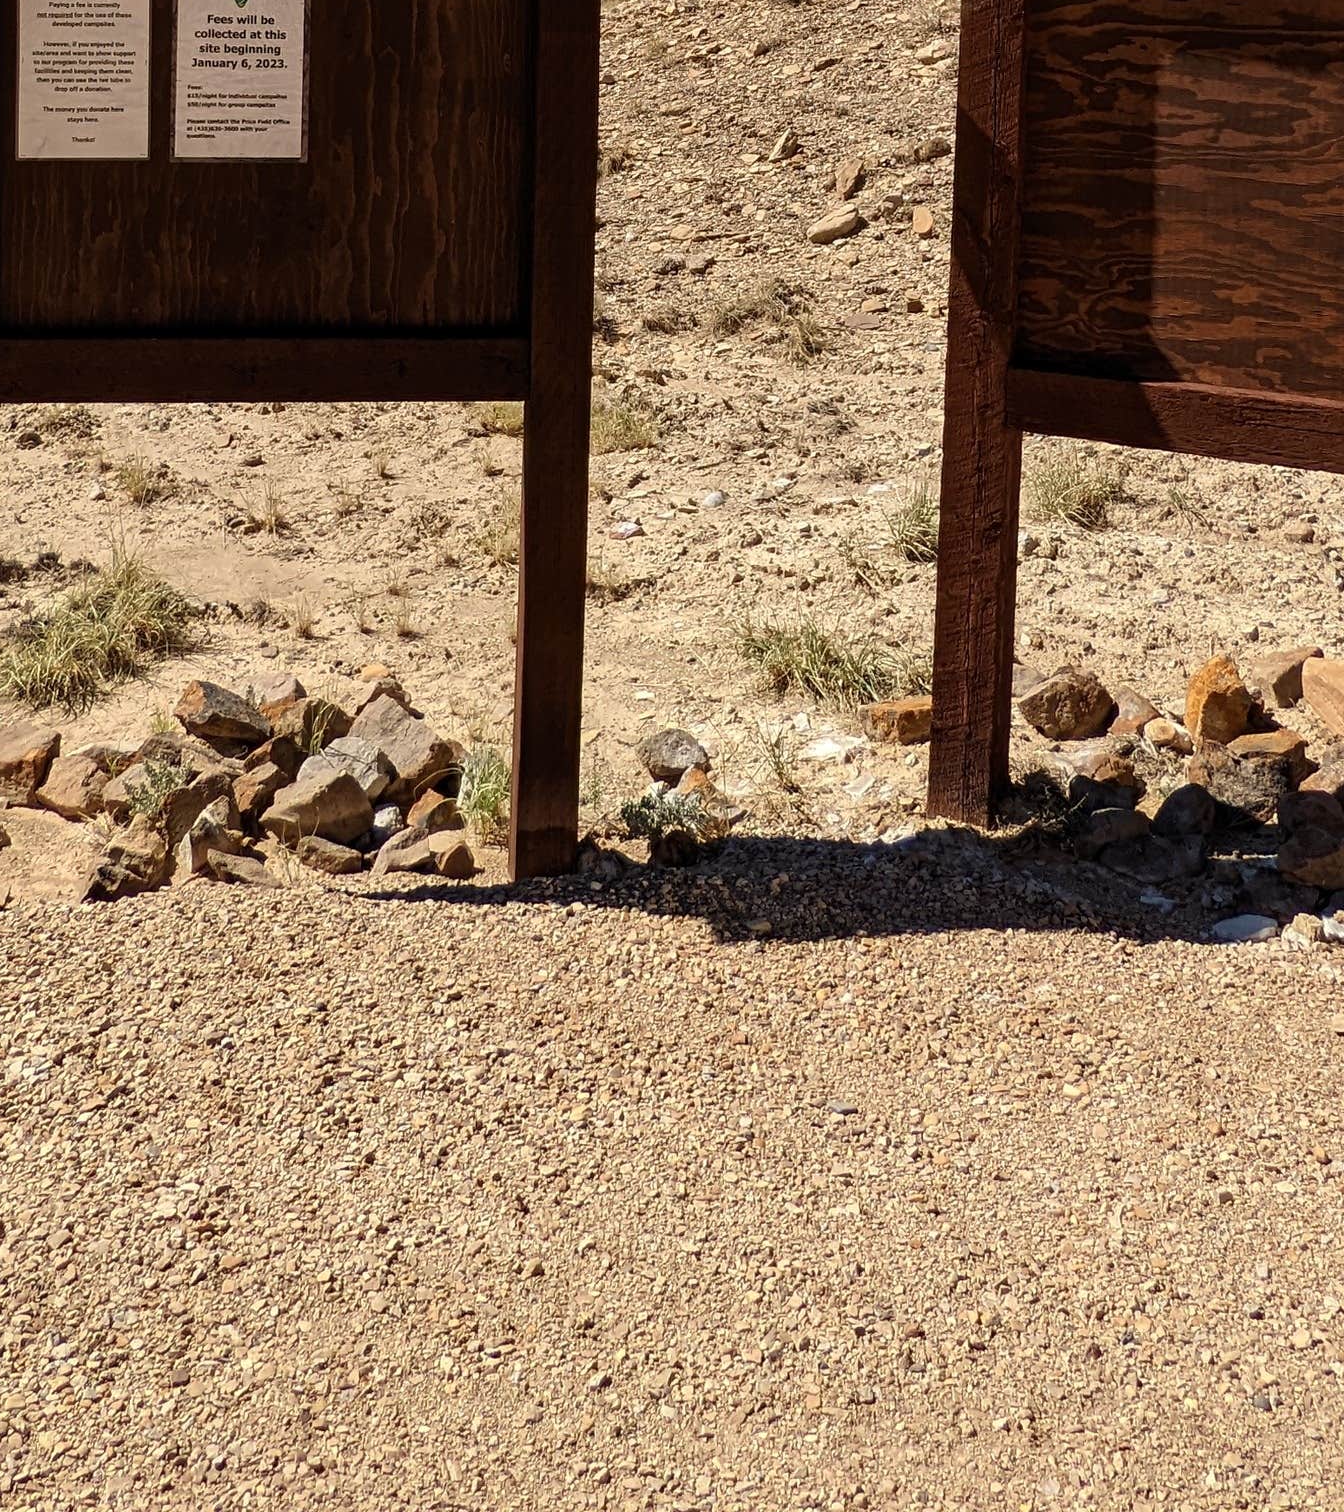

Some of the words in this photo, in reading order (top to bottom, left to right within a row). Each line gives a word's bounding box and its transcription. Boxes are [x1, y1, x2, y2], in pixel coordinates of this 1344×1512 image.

[207, 14, 234, 24] Fees
[237, 15, 257, 25] will
[261, 15, 275, 25] be
[194, 29, 247, 39] collected
[250, 30, 262, 39] at
[265, 30, 287, 40] this
[199, 43, 221, 53] site
[224, 44, 281, 56] beginning
[192, 58, 238, 70] January
[241, 59, 252, 70] 6,
[255, 59, 288, 69] 2023.
